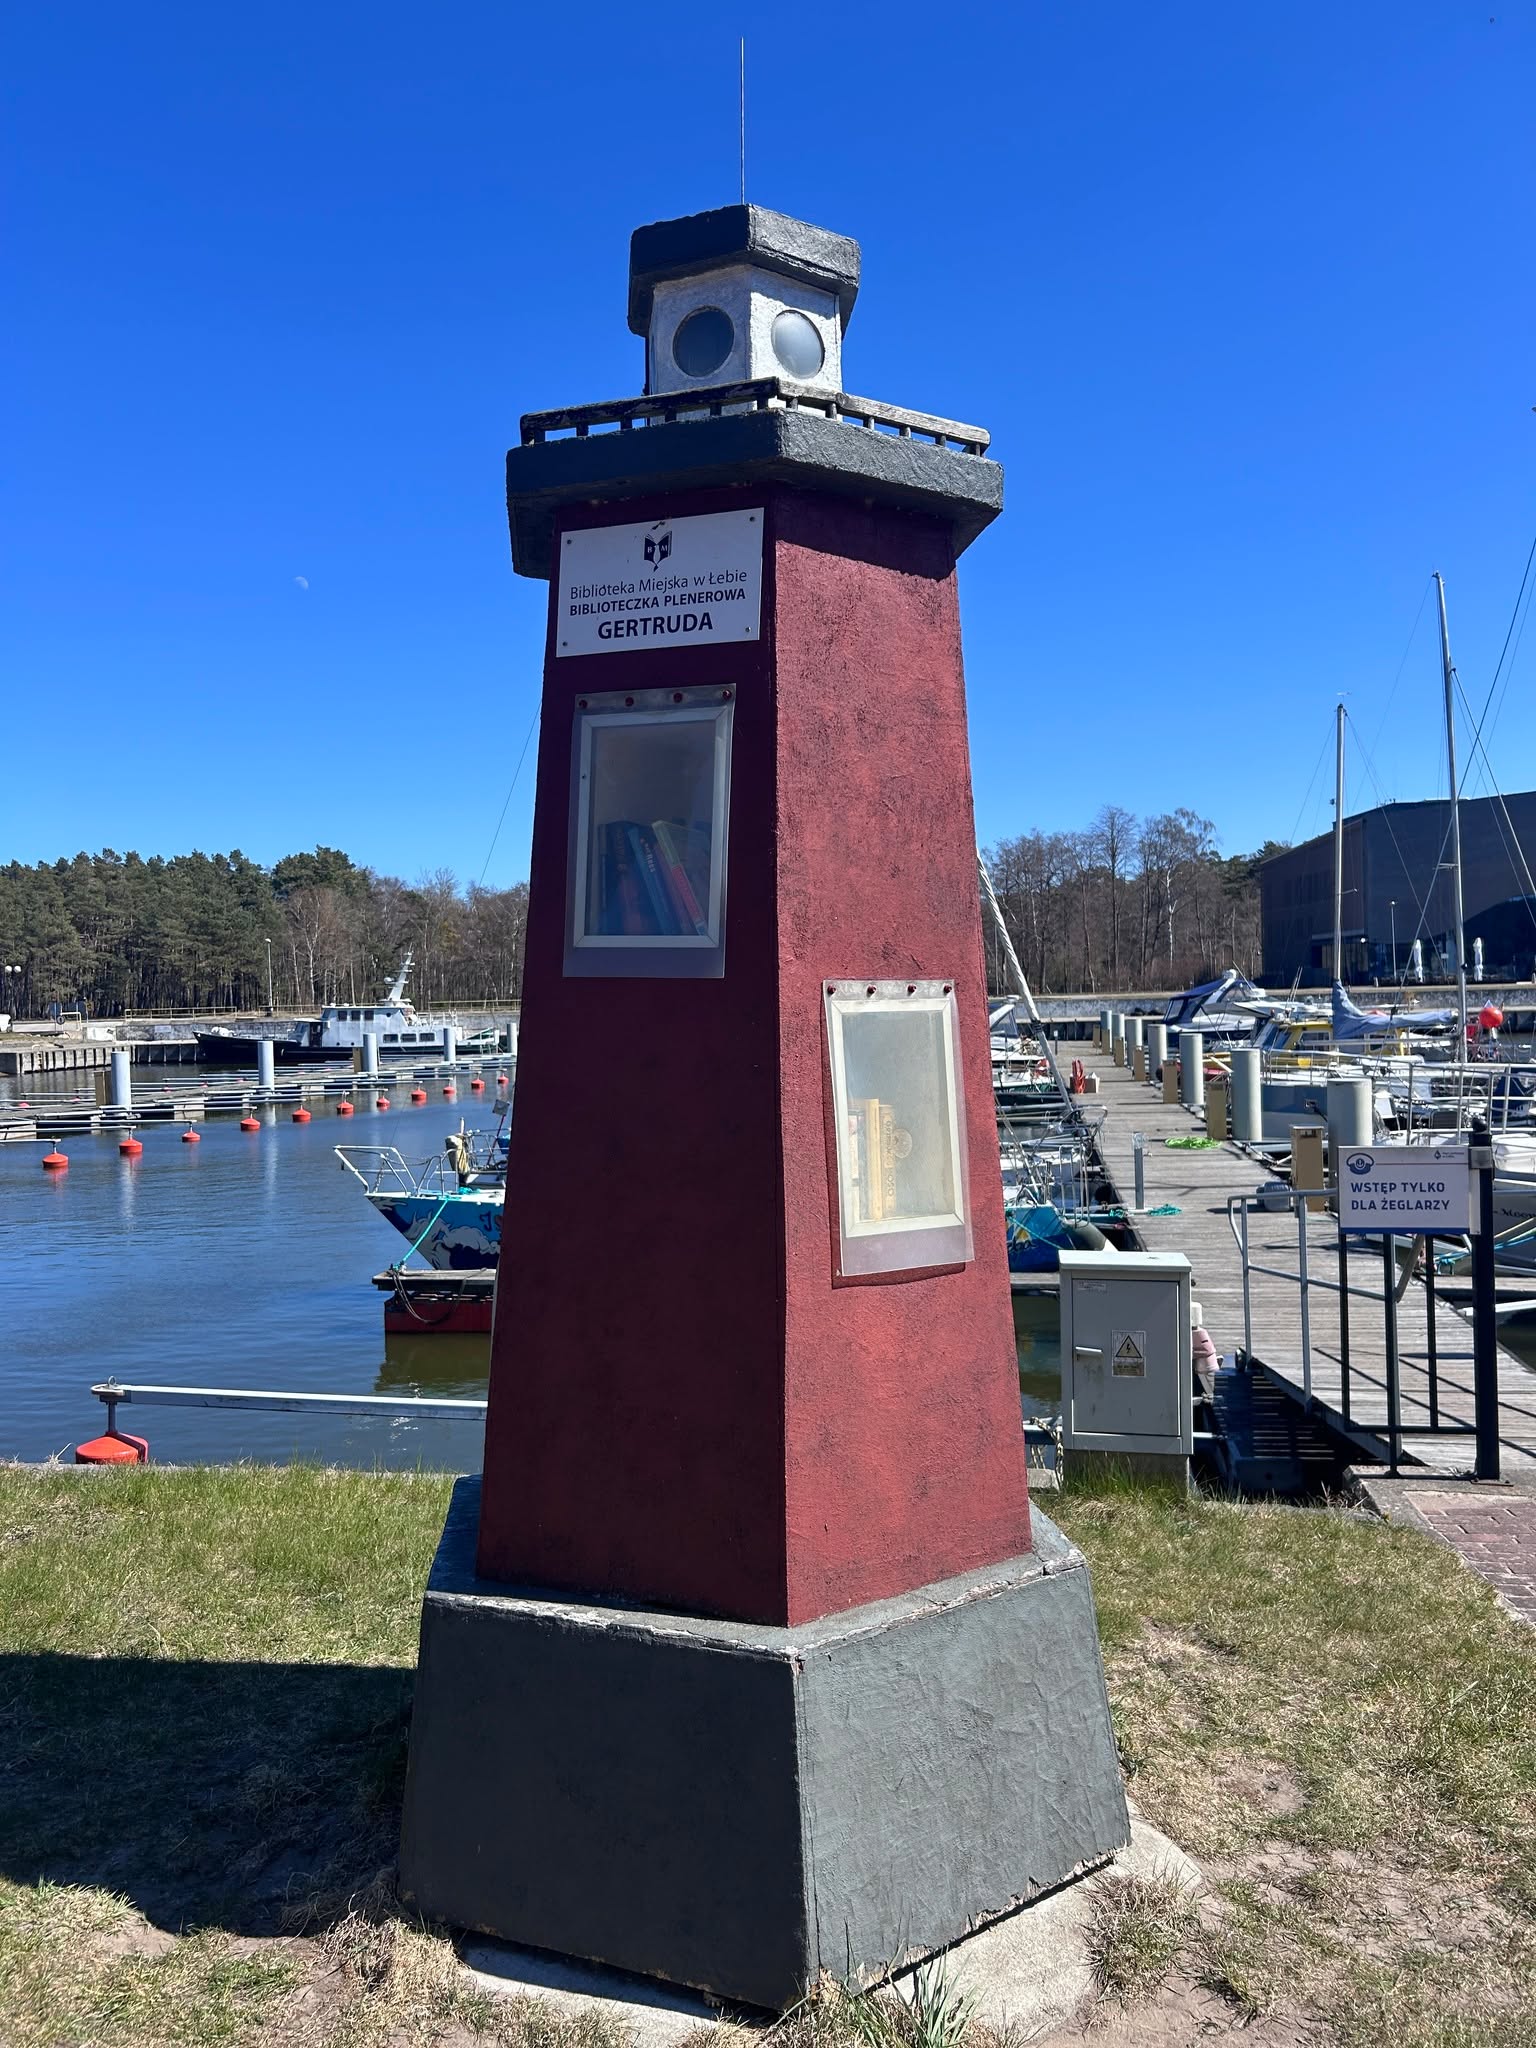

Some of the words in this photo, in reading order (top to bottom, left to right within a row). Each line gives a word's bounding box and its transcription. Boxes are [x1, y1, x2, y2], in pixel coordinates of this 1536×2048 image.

[570, 580, 635, 600] Biblioteka
[638, 575, 688, 594] Miejska
[693, 576, 706, 586] w
[708, 569, 748, 585] Łebie
[569, 596, 660, 617] BIBLIOTECZKA
[663, 588, 746, 607] PLENEROWA
[597, 611, 714, 640] GERTRUDA
[1350, 1182, 1397, 1195] WSTĘP
[1401, 1182, 1445, 1193] TYLKO
[1351, 1200, 1377, 1211] DLA
[1381, 1197, 1450, 1211] ŻEGLARZY
